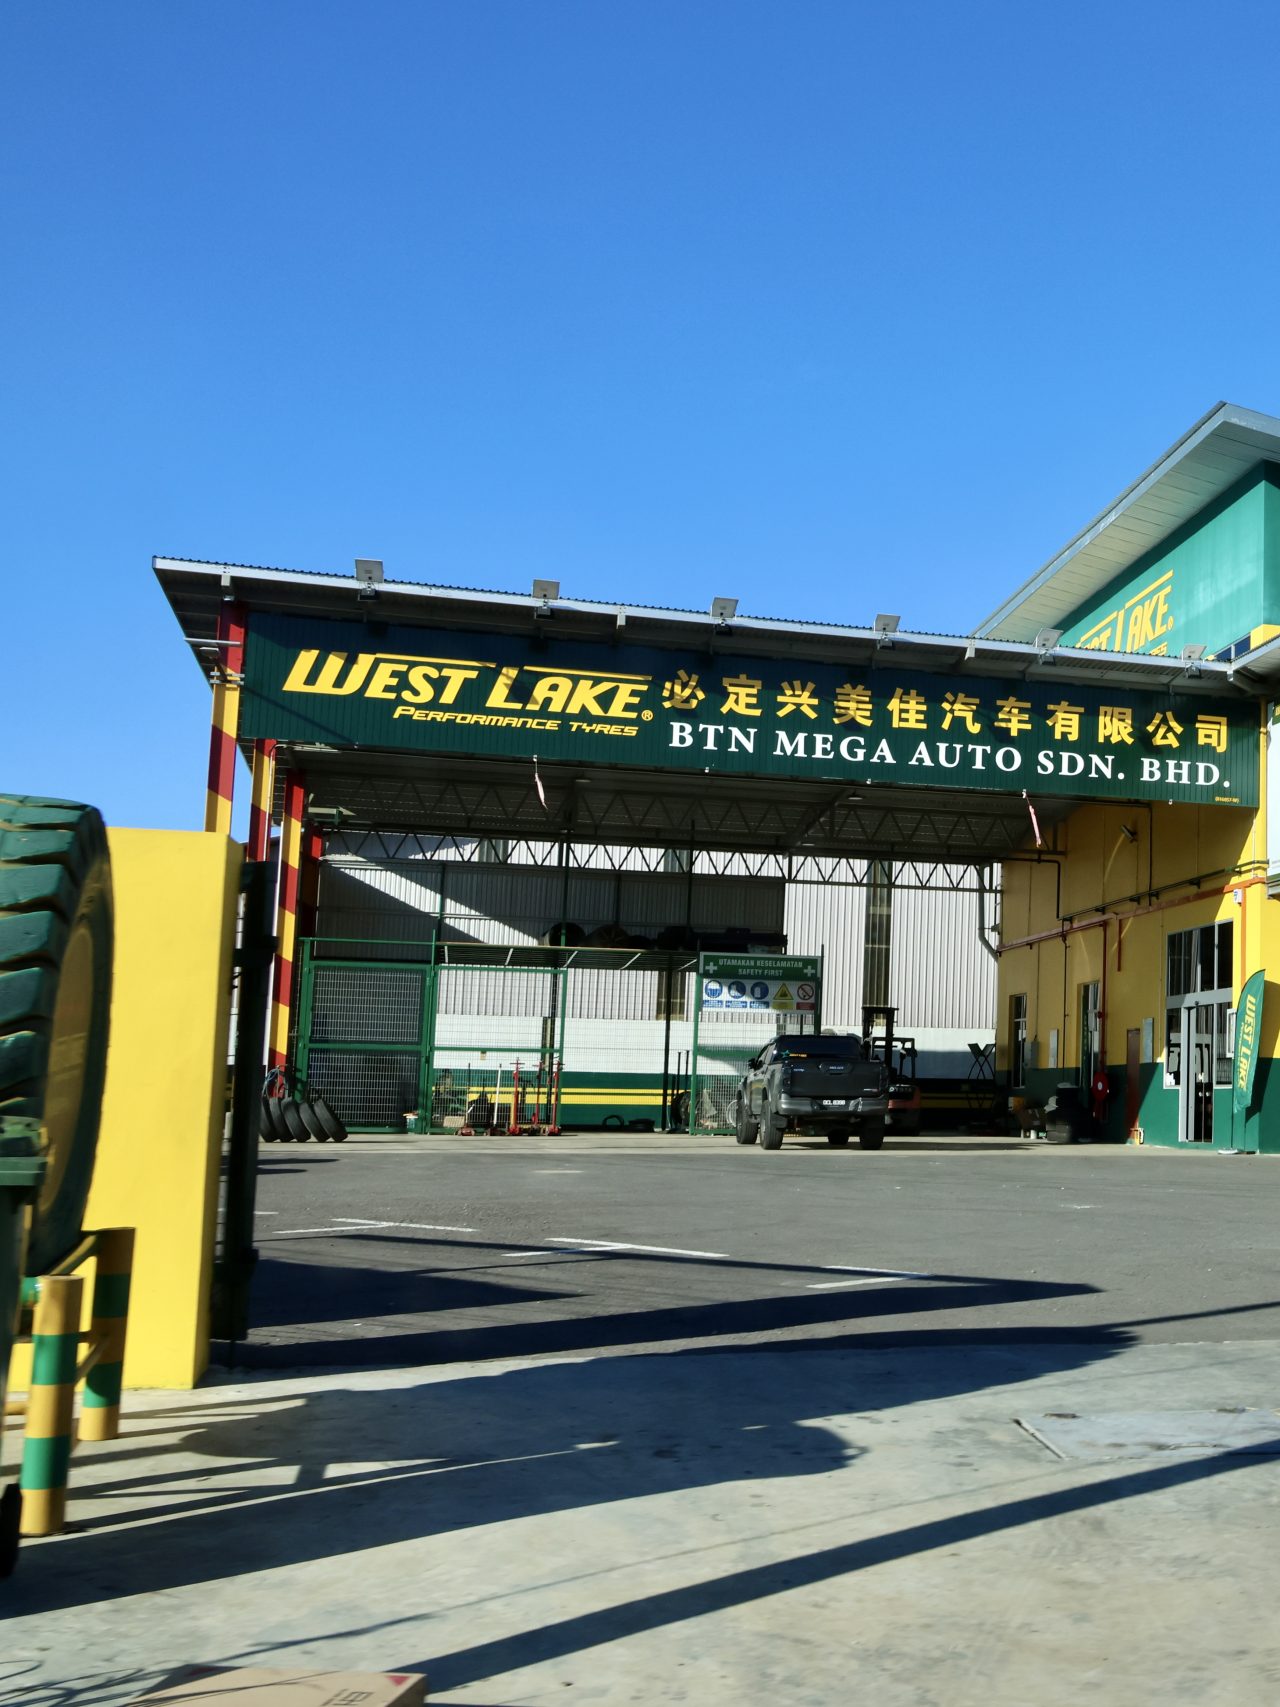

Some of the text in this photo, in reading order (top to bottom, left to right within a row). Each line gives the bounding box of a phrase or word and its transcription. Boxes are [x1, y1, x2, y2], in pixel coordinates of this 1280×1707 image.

[282, 649, 653, 719] WEST LAKE
[393, 705, 639, 737] PERFORMANCE TYRES
[661, 669, 1229, 753] 必定兴美佳汽车有限公司
[669, 721, 1232, 788] BTN MEGA AUTO SDN. BHD.
[719, 958, 803, 968] UTAMAKAN KESELAMATAN
[738, 968, 783, 977] SAFETY FIRST
[1244, 994, 1256, 1045] WEST
[1238, 1045, 1252, 1092] LAKE
